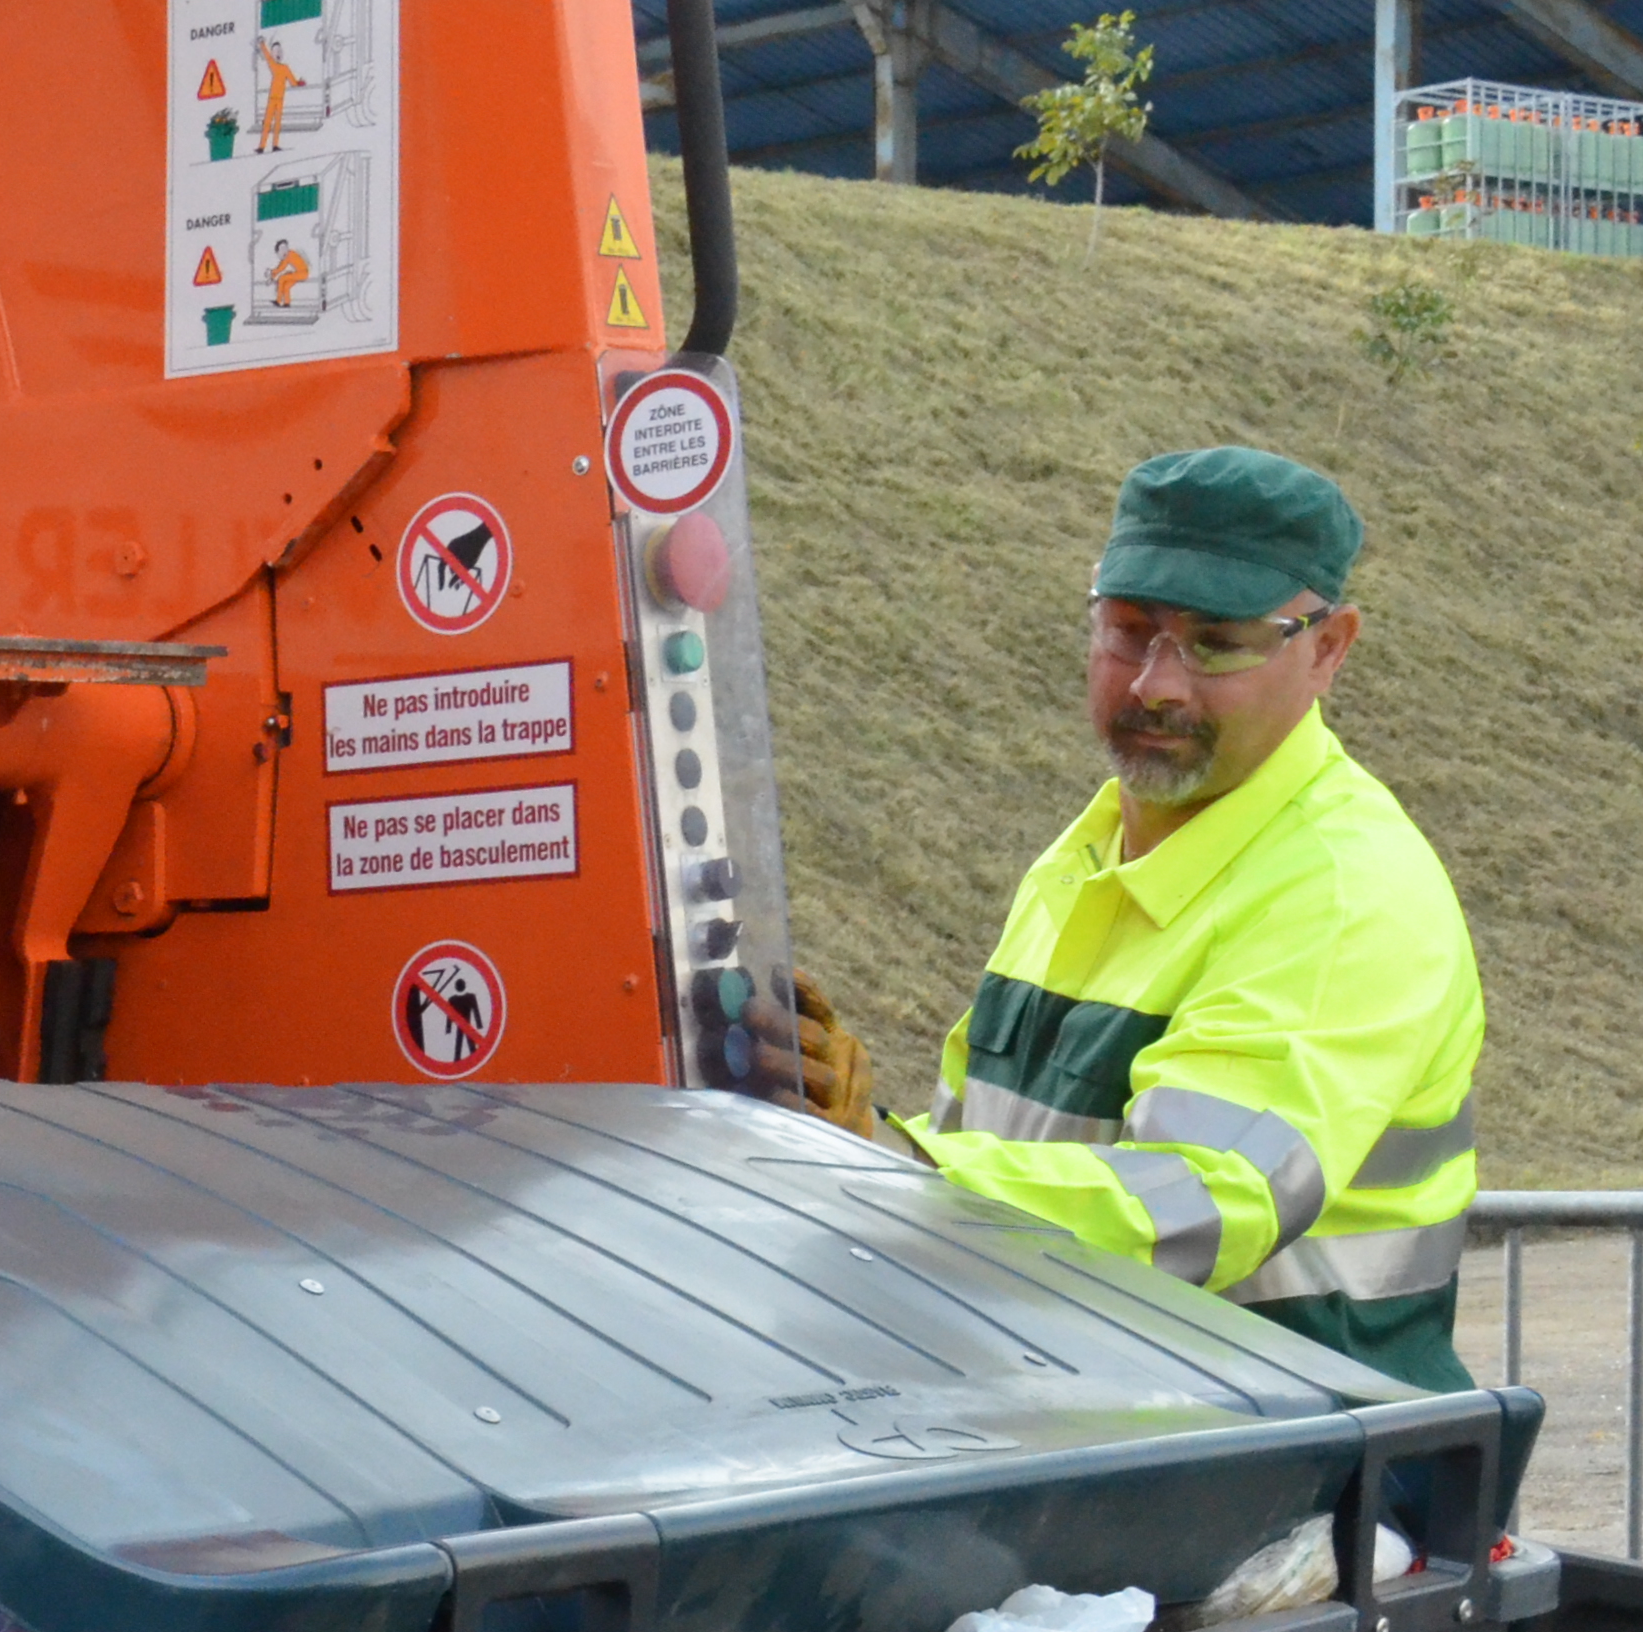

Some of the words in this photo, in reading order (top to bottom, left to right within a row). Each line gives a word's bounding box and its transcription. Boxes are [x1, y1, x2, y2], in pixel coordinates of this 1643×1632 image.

[190, 22, 235, 41] DANGER
[186, 213, 231, 232] DANGER
[649, 403, 686, 421] ZÔNE
[634, 418, 703, 441] INTERDITE
[633, 440, 676, 459] ENTRE
[680, 436, 706, 450] LES
[632, 452, 709, 477] BARRIÈRES
[363, 694, 388, 719] Ne
[394, 694, 428, 720] pas
[434, 680, 530, 711] introduire
[329, 734, 356, 758] les
[362, 729, 419, 755] mains
[425, 725, 472, 749] dans
[478, 720, 496, 744] la
[502, 717, 567, 746] trappe
[343, 815, 368, 840] Ne
[375, 815, 408, 842] pas
[414, 813, 436, 834] se
[443, 806, 505, 837] placer
[512, 801, 561, 824] dans
[336, 853, 354, 877] la
[360, 853, 403, 875] zone
[410, 847, 433, 871] de
[440, 836, 570, 868] basculement
